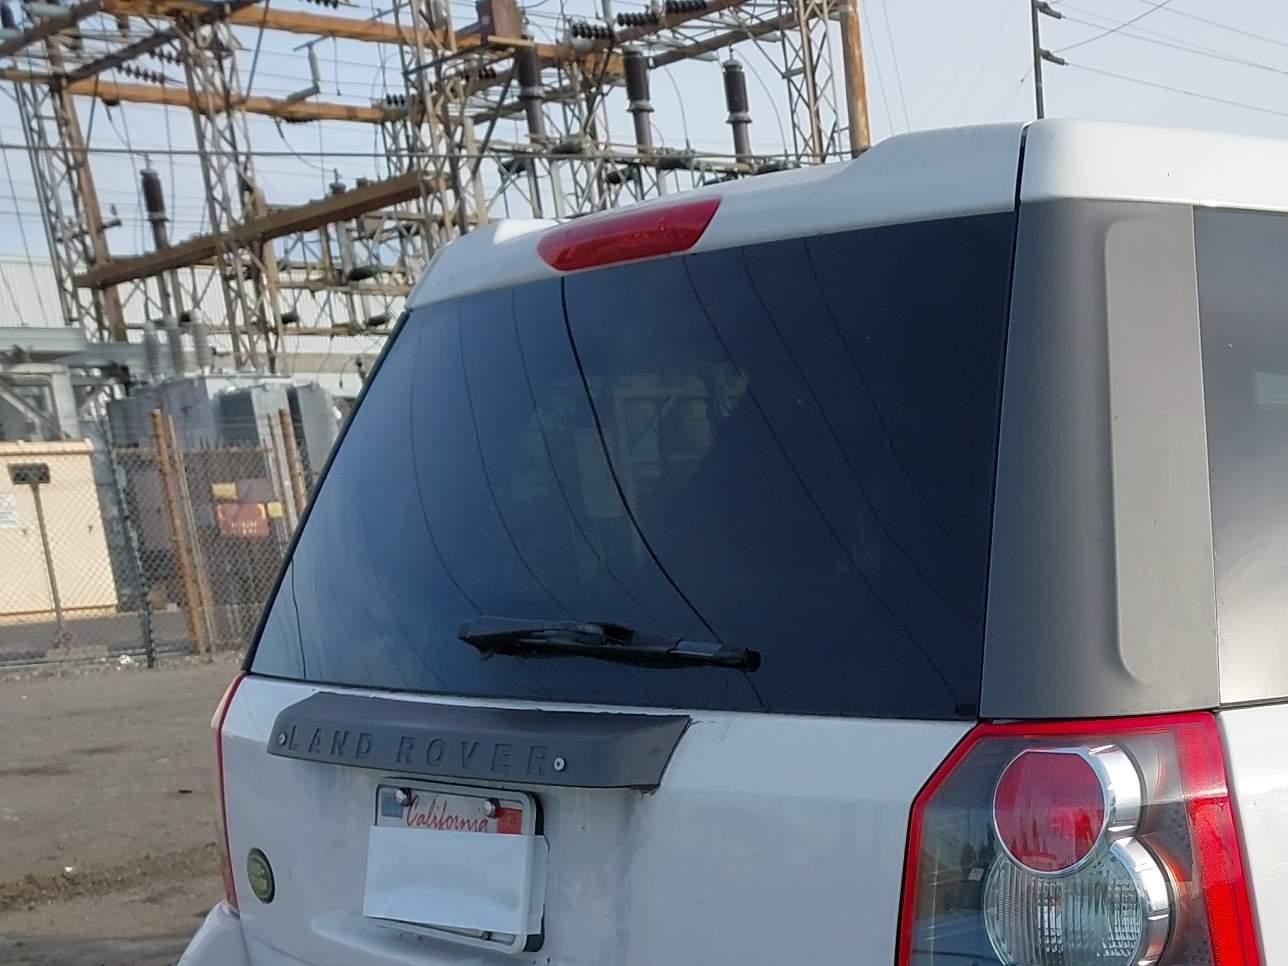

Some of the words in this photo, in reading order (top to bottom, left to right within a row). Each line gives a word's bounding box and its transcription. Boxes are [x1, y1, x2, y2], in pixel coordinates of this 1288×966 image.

[288, 725, 374, 759] LAND
[396, 735, 549, 777] ROVER
[406, 794, 489, 833] California
